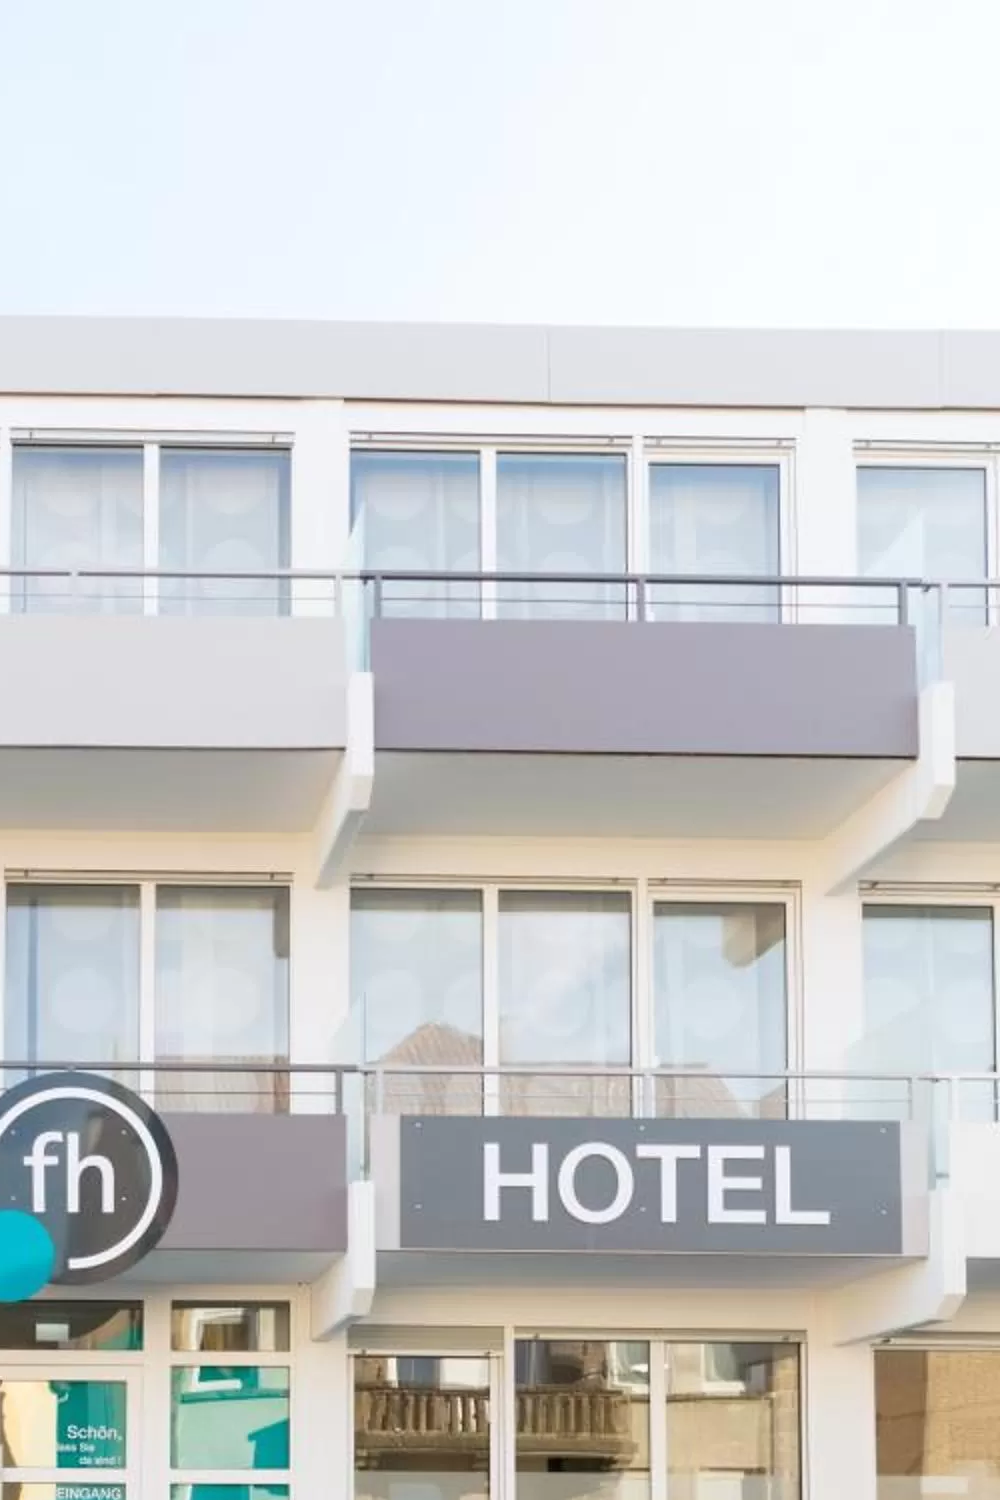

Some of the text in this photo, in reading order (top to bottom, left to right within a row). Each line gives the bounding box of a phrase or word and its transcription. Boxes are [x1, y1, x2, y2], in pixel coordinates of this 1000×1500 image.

[23, 1131, 115, 1213] fh
[483, 1141, 831, 1225] HOTEL
[56, 1487, 121, 1500] EINGANG
